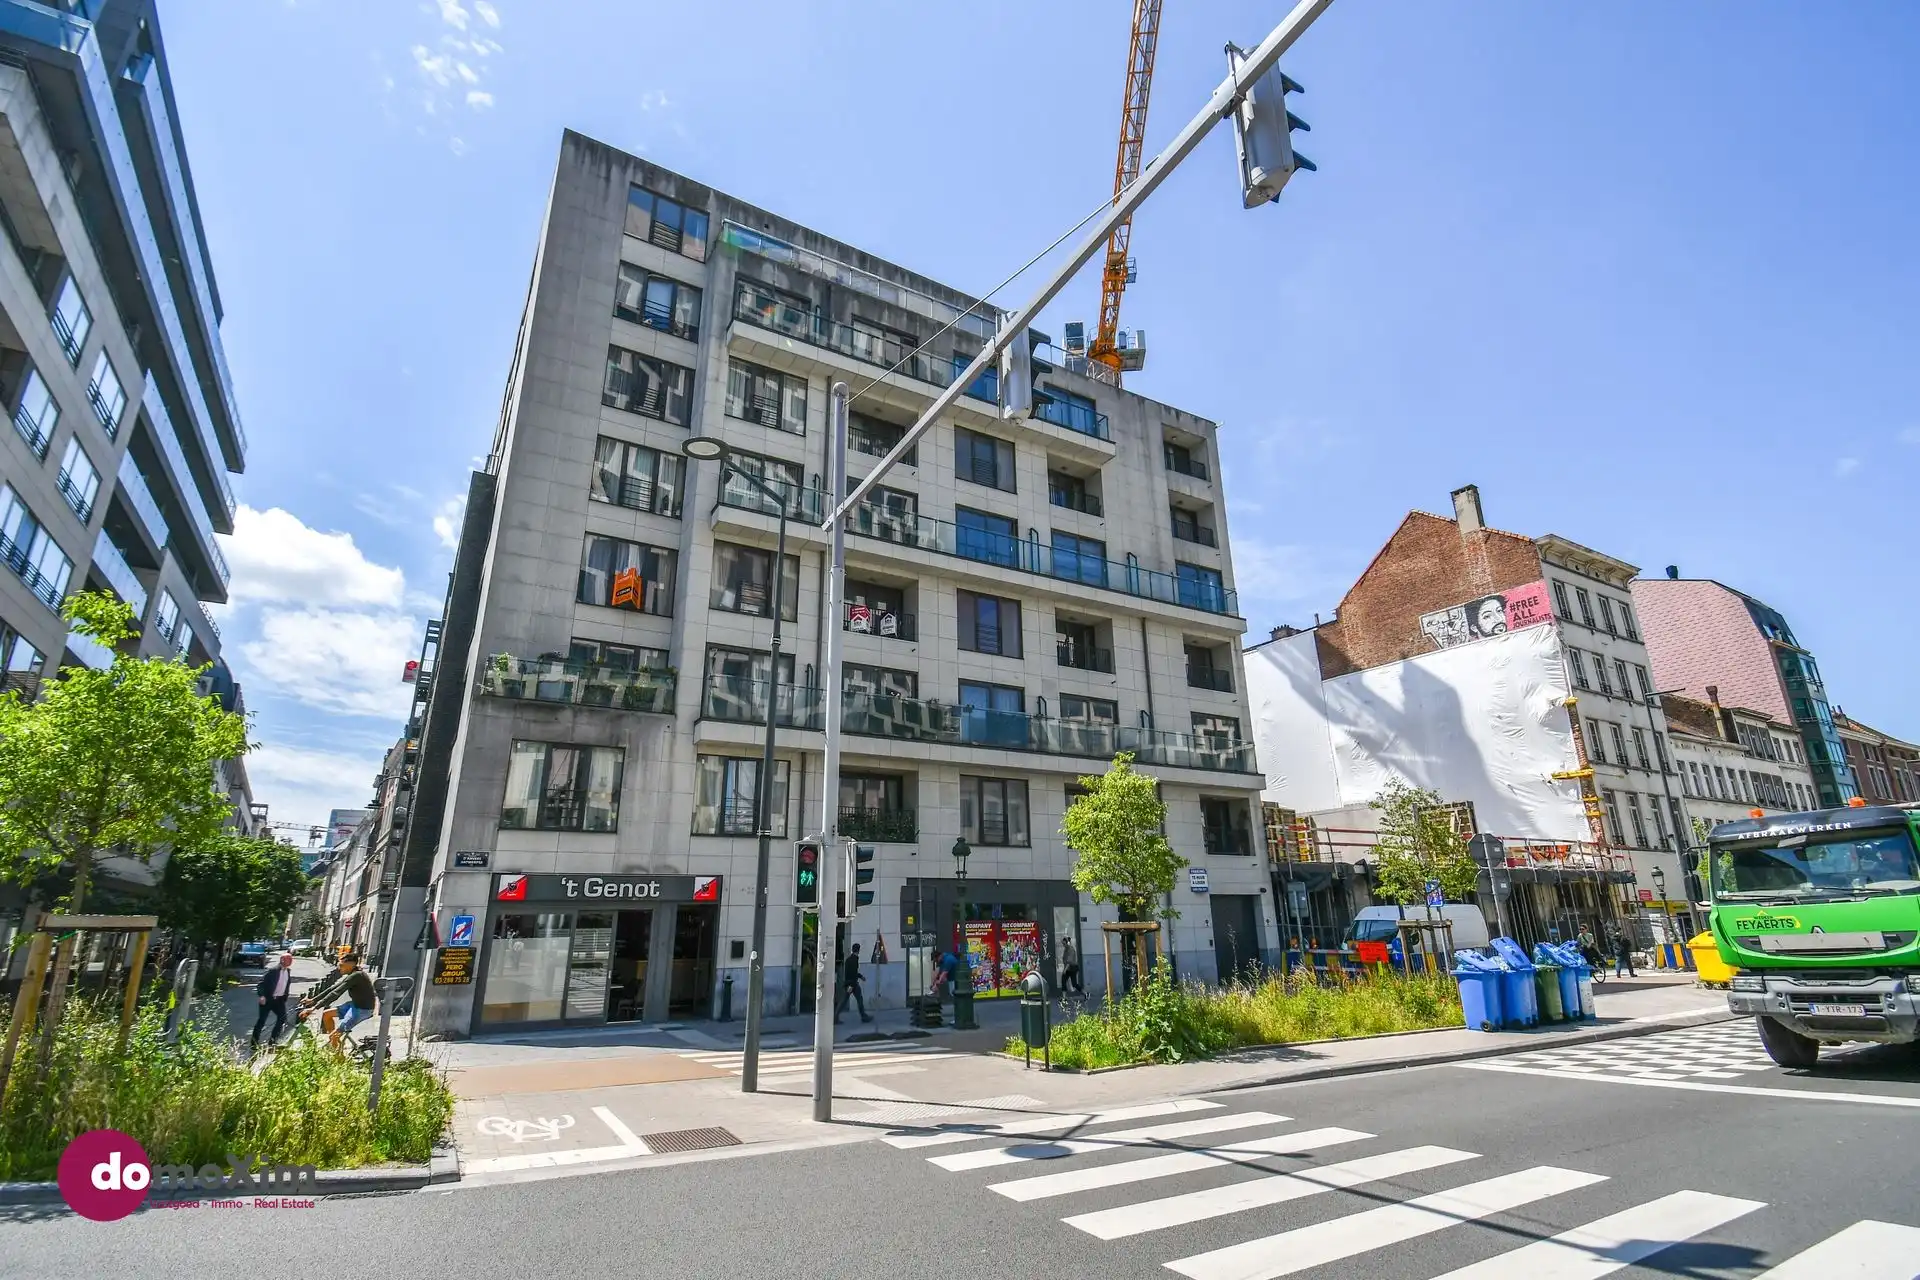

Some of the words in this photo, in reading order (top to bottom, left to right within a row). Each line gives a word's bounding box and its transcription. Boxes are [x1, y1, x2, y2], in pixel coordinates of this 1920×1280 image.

[1509, 596, 1540, 613] #FREE
[1513, 609, 1536, 622] ALL
[1513, 613, 1553, 629] JOURNALISTS
[1737, 822, 1852, 840] AFBRAAKWERKEN
[583, 877, 660, 898] Genot
[1736, 918, 1795, 930] FEYAERTS
